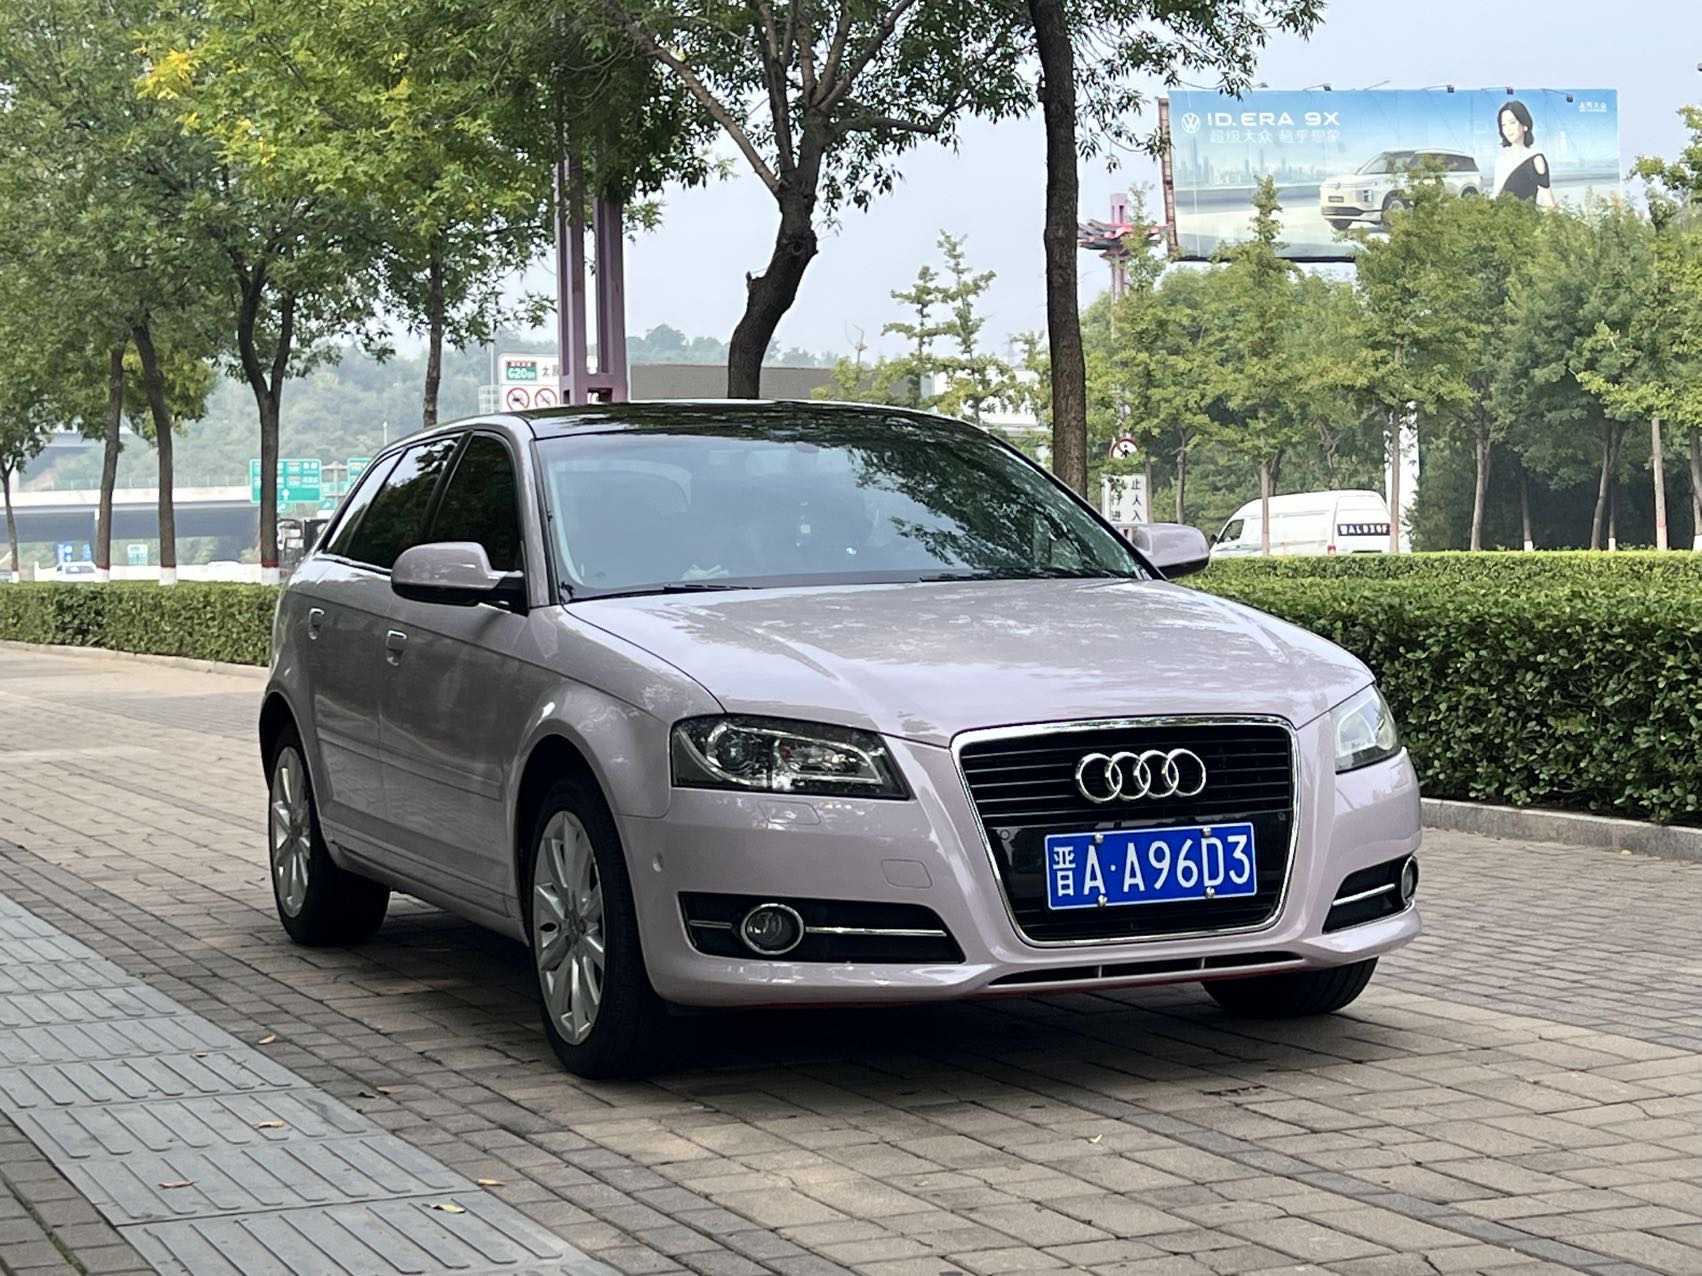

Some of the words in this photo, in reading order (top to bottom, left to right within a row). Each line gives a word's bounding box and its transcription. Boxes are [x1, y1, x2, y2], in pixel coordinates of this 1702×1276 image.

[1207, 112, 1294, 127] ID.ERA
[1304, 112, 1340, 126] 9X
[1209, 129, 1273, 143] 超级大众
